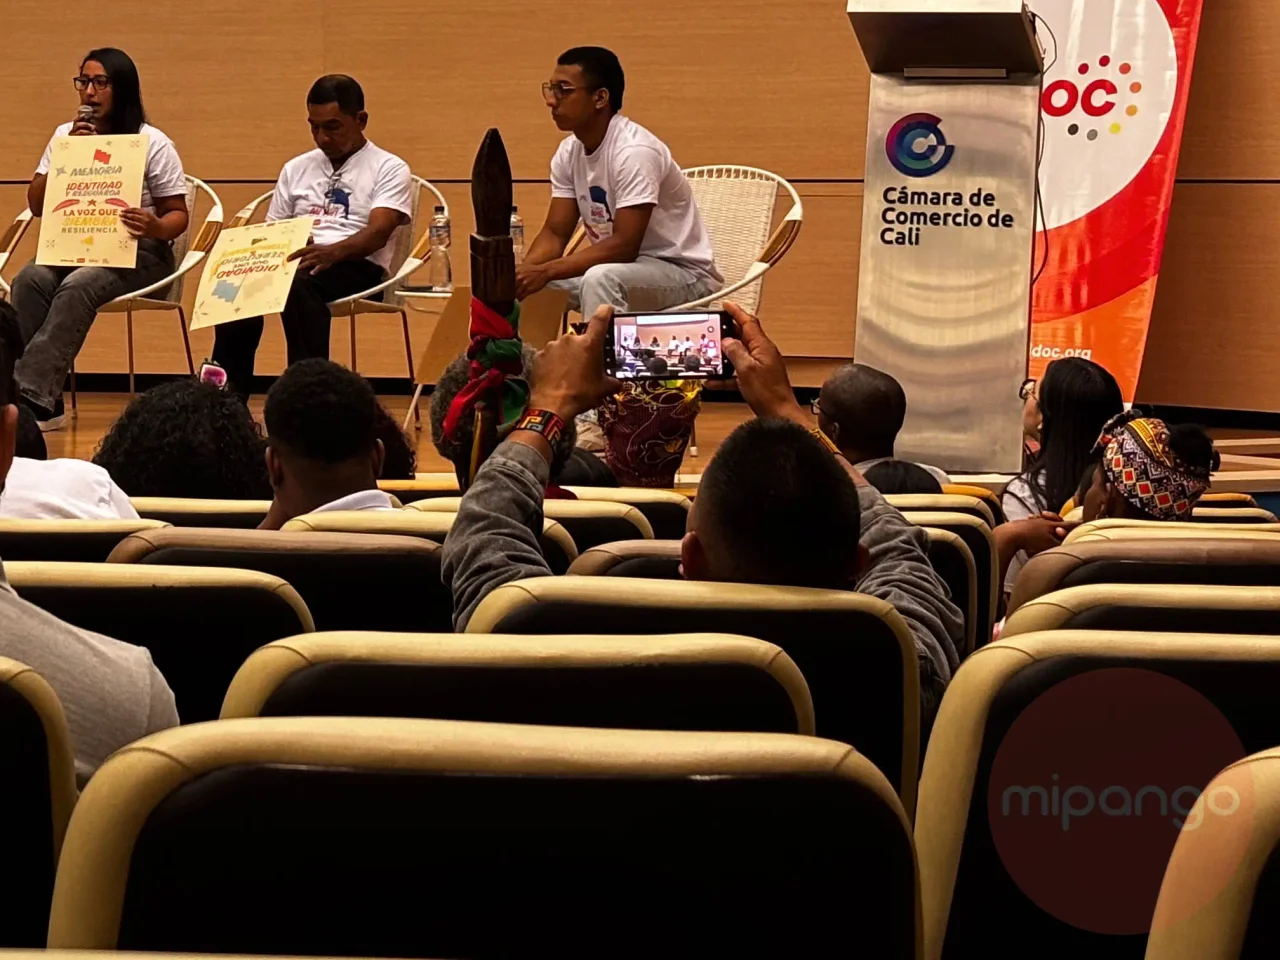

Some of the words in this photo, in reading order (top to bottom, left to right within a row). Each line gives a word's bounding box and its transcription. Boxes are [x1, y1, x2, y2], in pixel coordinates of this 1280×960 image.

[70, 165, 122, 177] MEMORIA
[66, 181, 123, 191] IDENTIDAD
[883, 186, 963, 206] Cámara
[969, 188, 996, 206] de
[881, 207, 983, 227] Comercio
[987, 209, 1014, 227] de
[880, 227, 921, 246] Cali
[216, 263, 280, 279] DIGNIDAD
